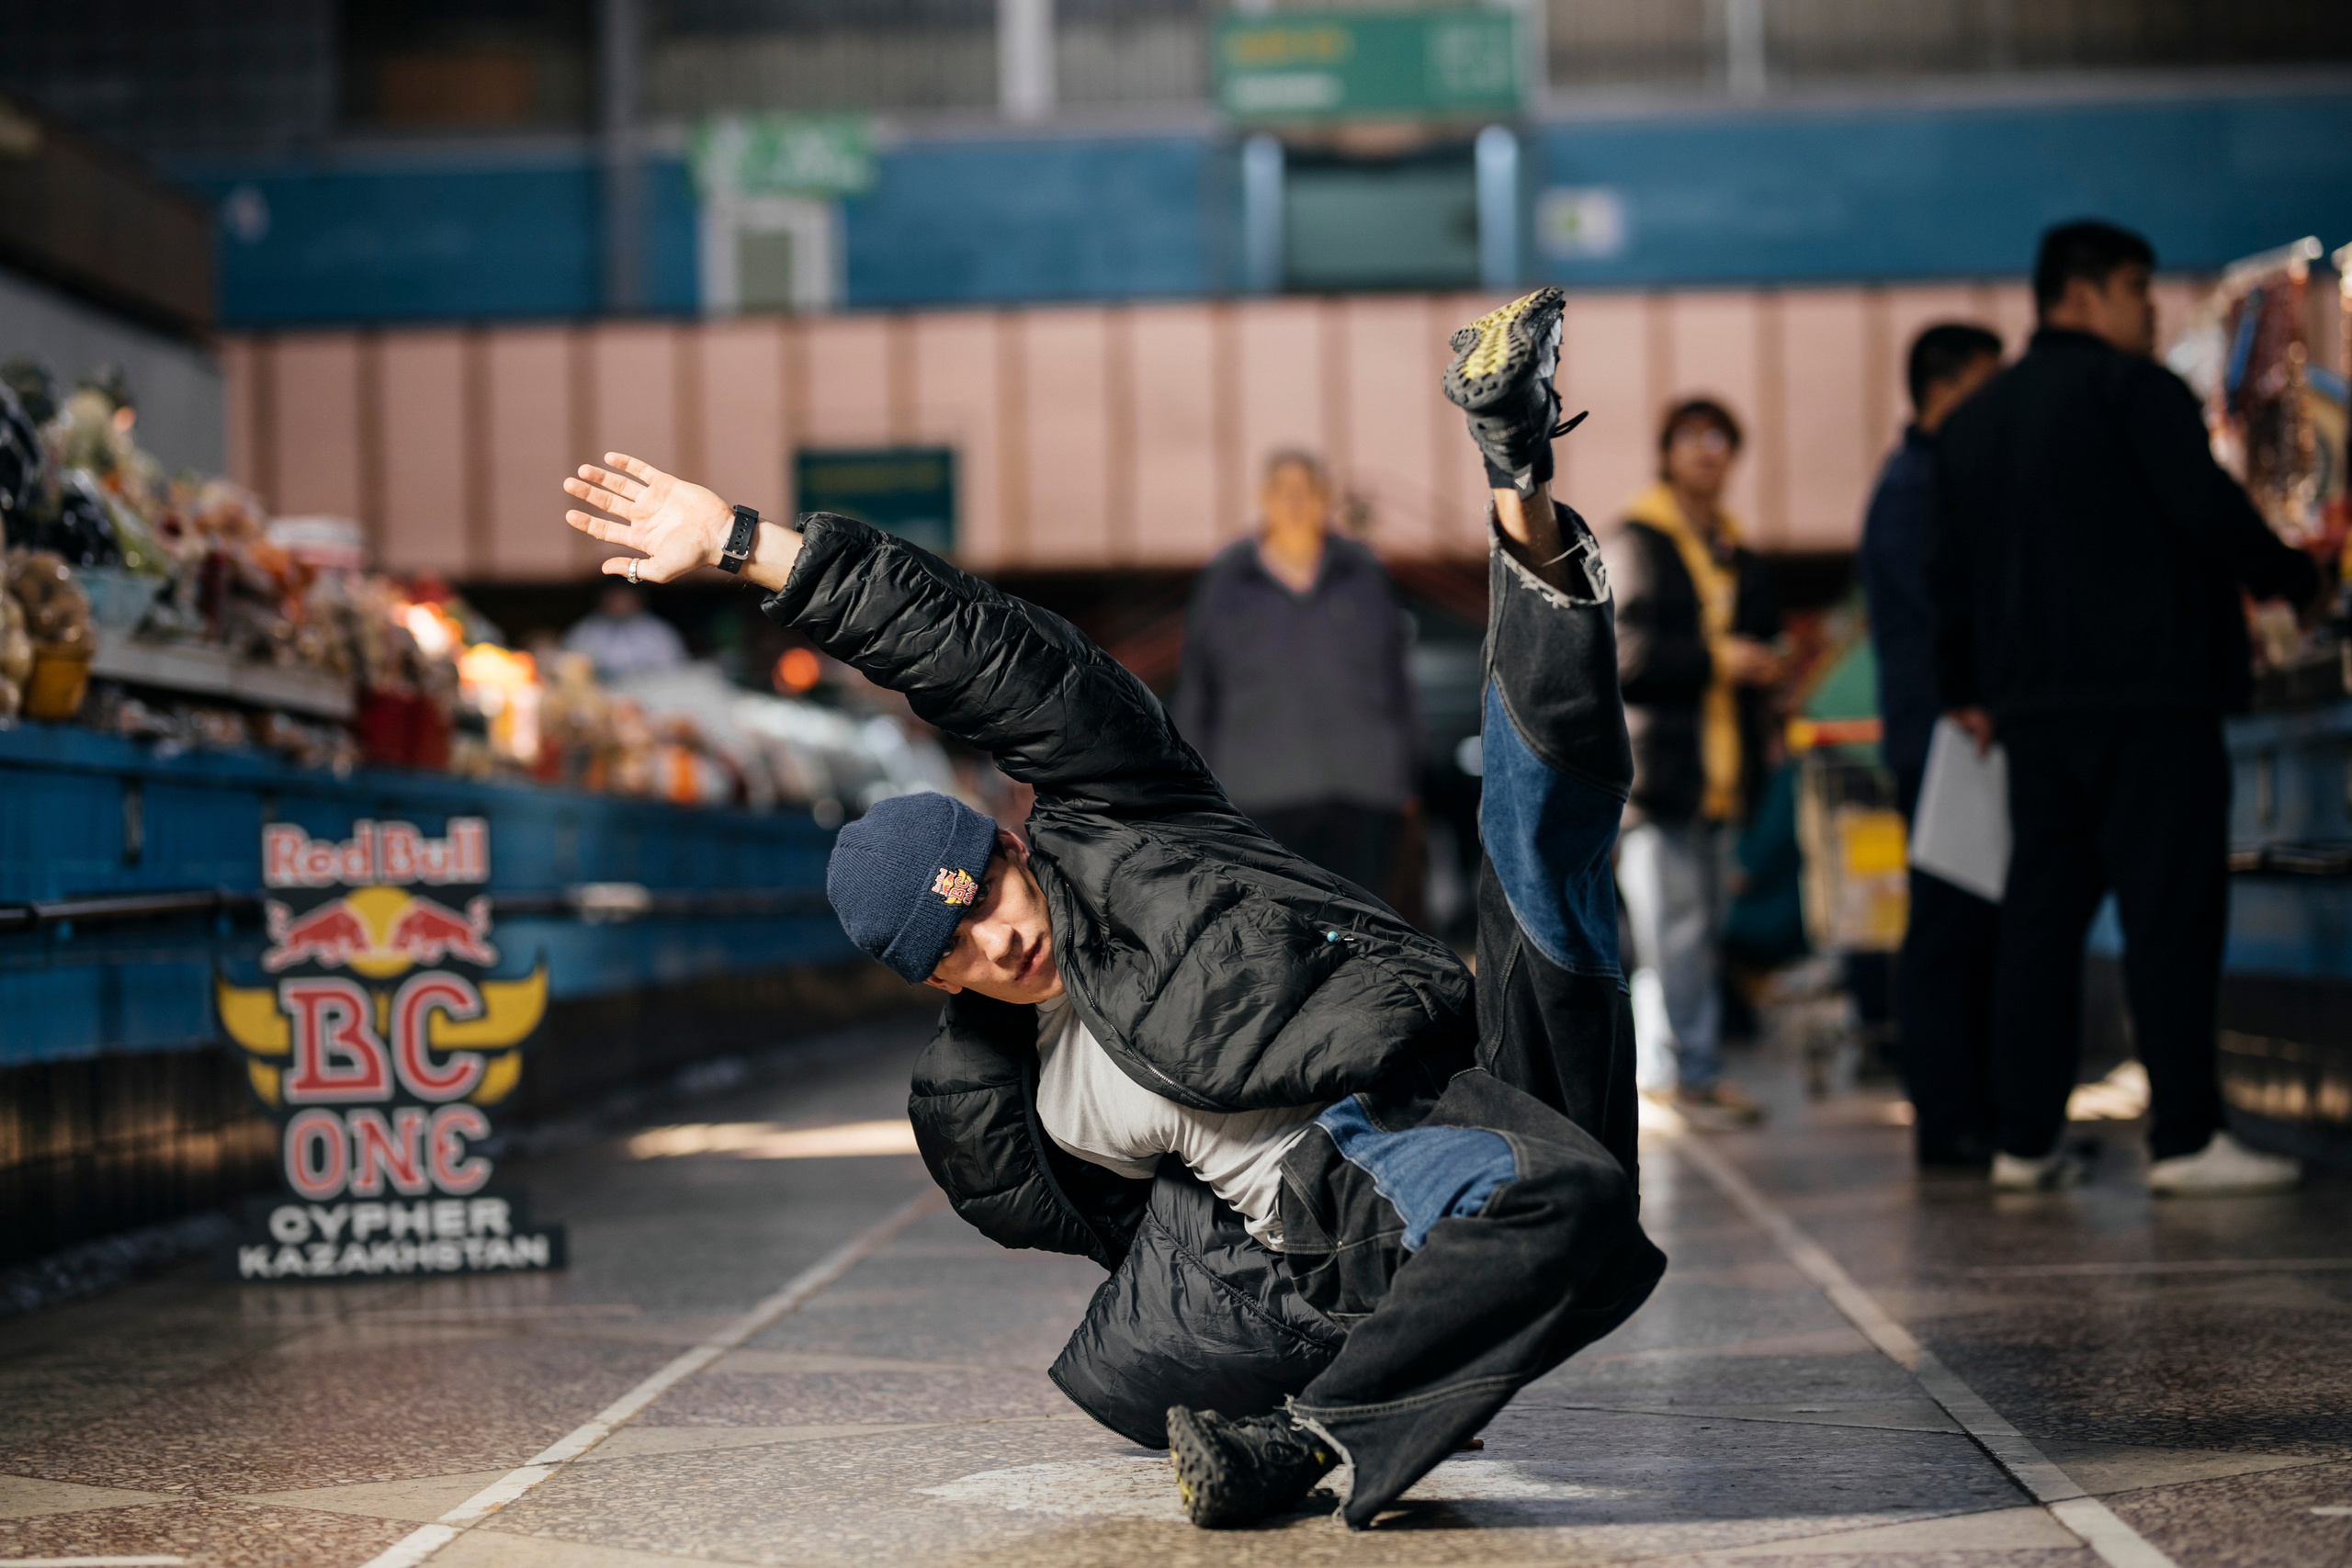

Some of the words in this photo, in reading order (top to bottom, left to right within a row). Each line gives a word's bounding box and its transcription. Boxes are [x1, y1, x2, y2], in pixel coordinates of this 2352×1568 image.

[265, 819, 373, 885] Red
[379, 817, 488, 883] Bull
[949, 877, 969, 901] BC
[963, 882, 978, 906] ONE
[281, 971, 486, 1102] BC
[285, 1105, 492, 1200] ONE
[269, 1199, 510, 1242] CYPHER
[239, 1235, 549, 1278] KAZAKHSTAN
